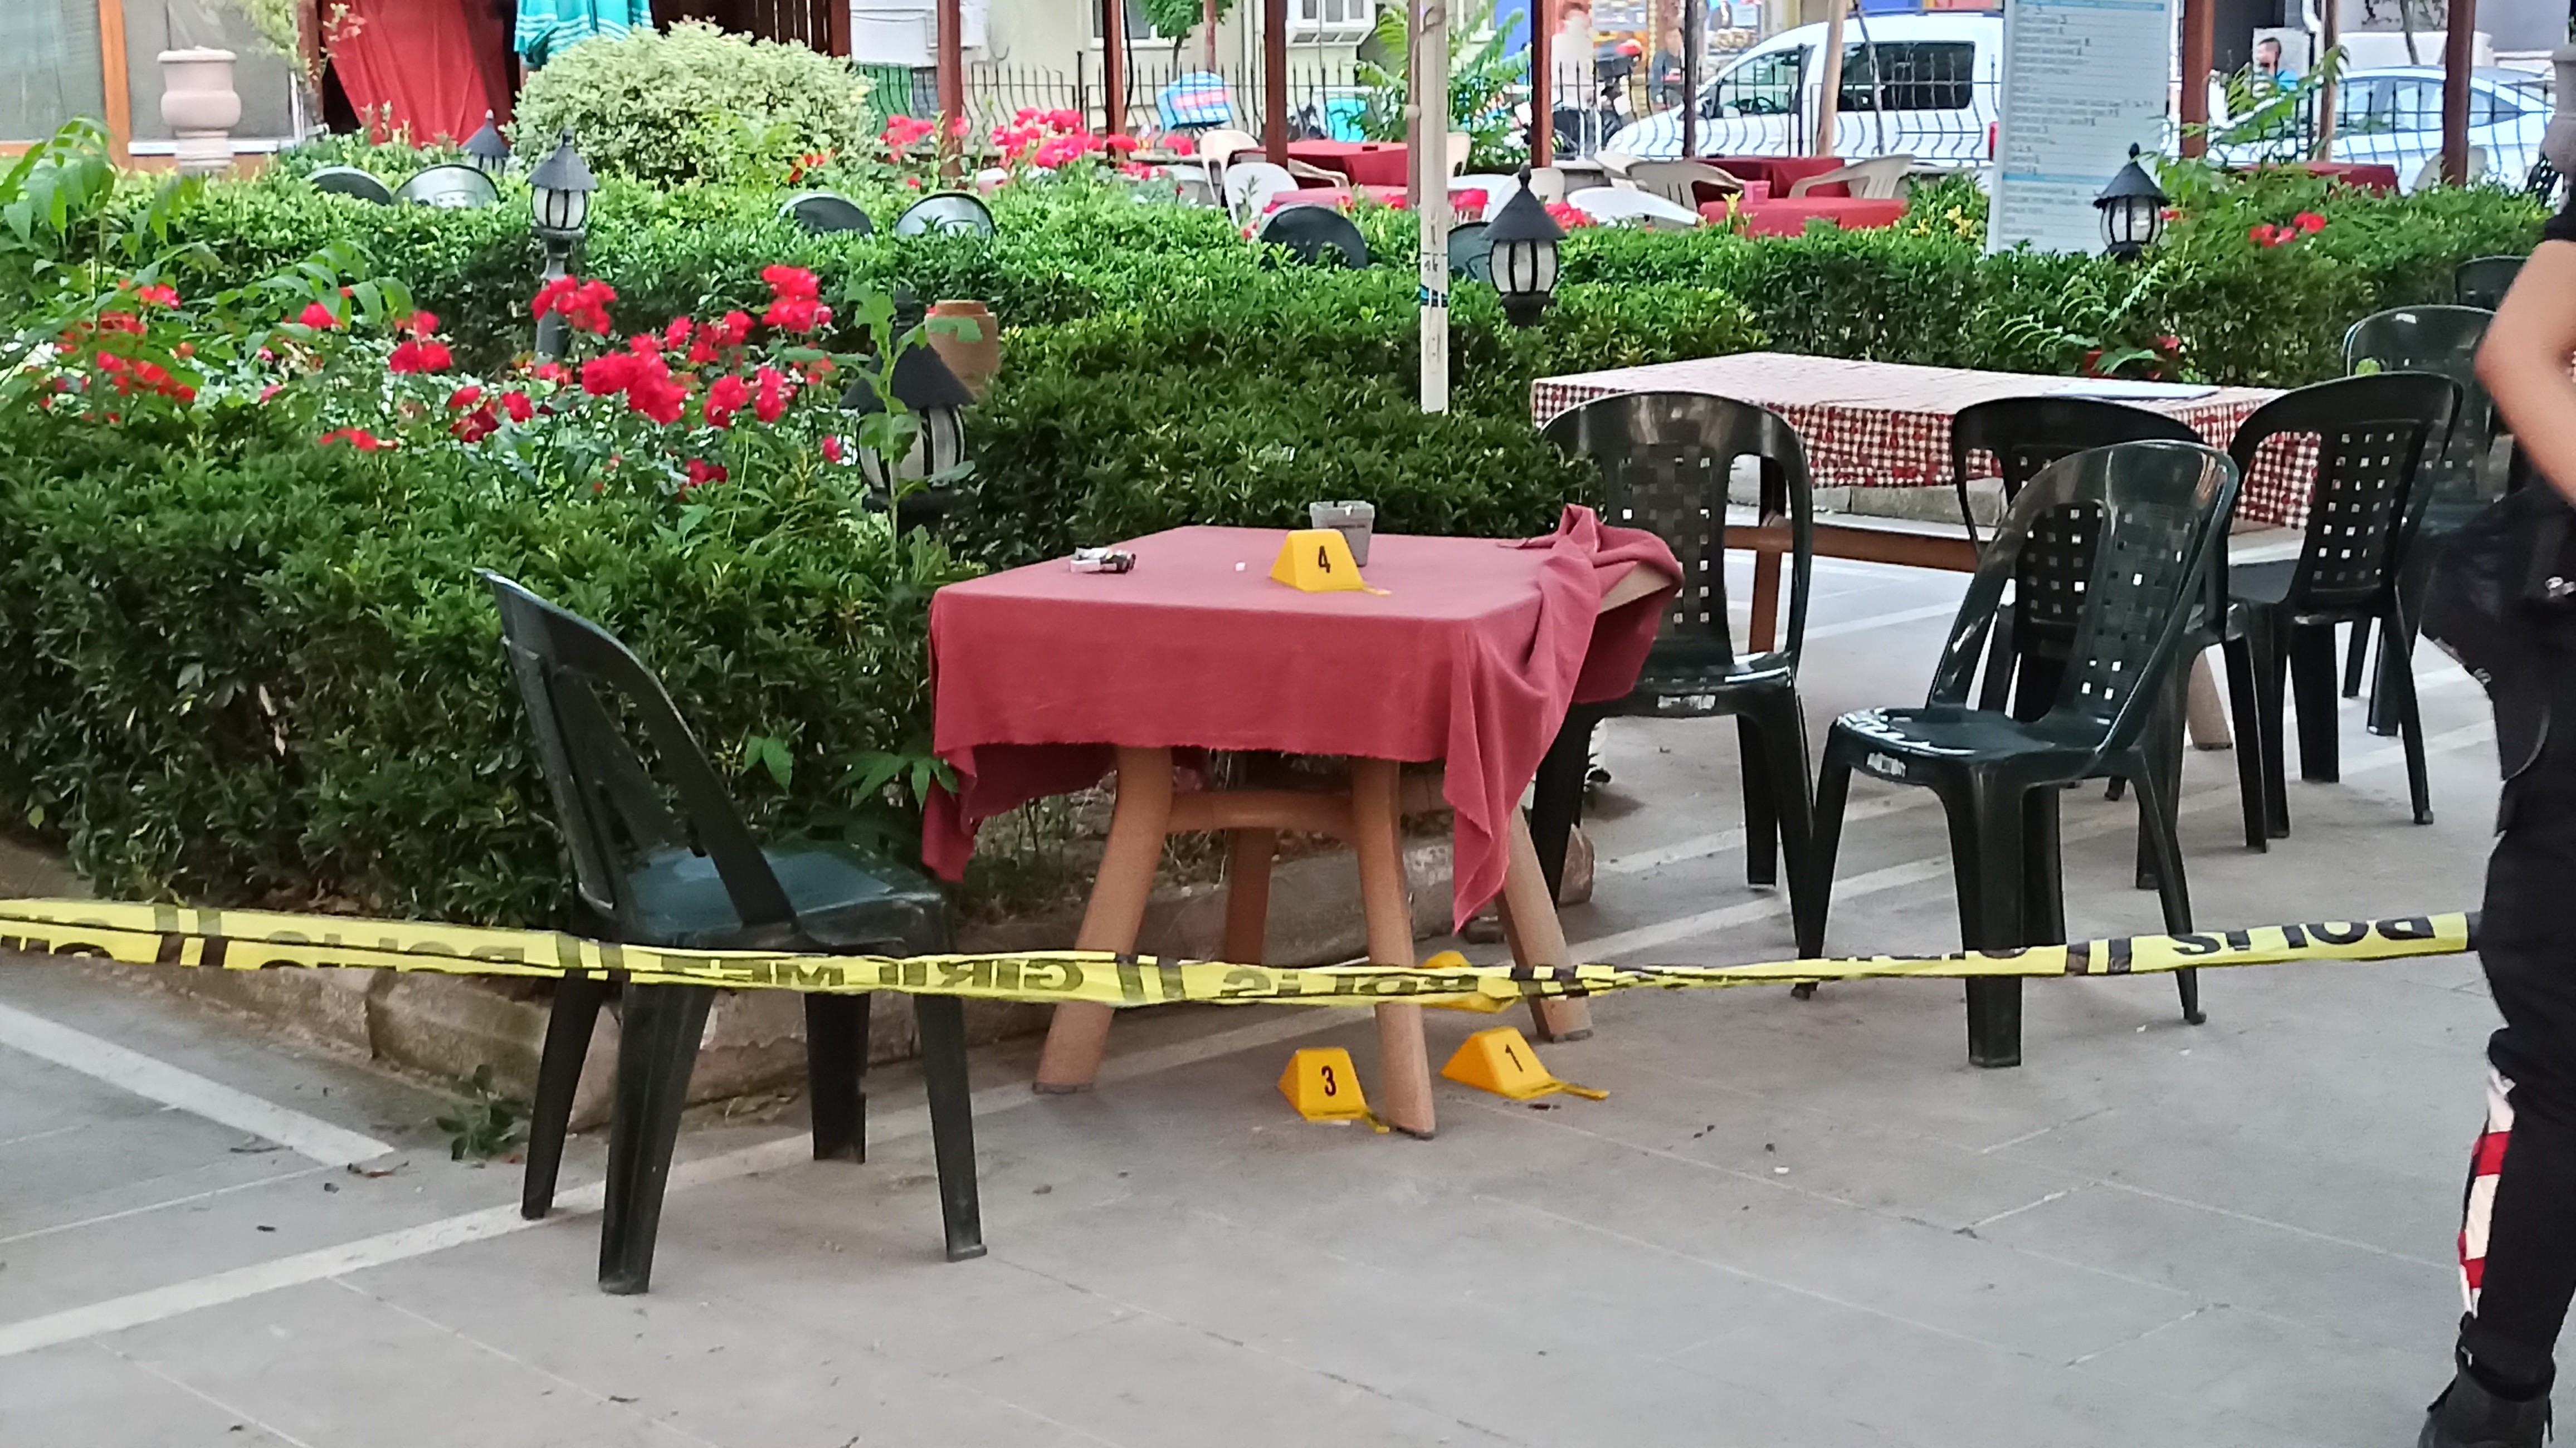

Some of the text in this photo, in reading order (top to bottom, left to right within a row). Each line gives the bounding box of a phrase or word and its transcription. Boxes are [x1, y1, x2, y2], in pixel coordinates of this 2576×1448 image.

[1319, 545, 1331, 574] 4
[1505, 1044, 1523, 1072] 1
[1321, 1065, 1336, 1097] 3
